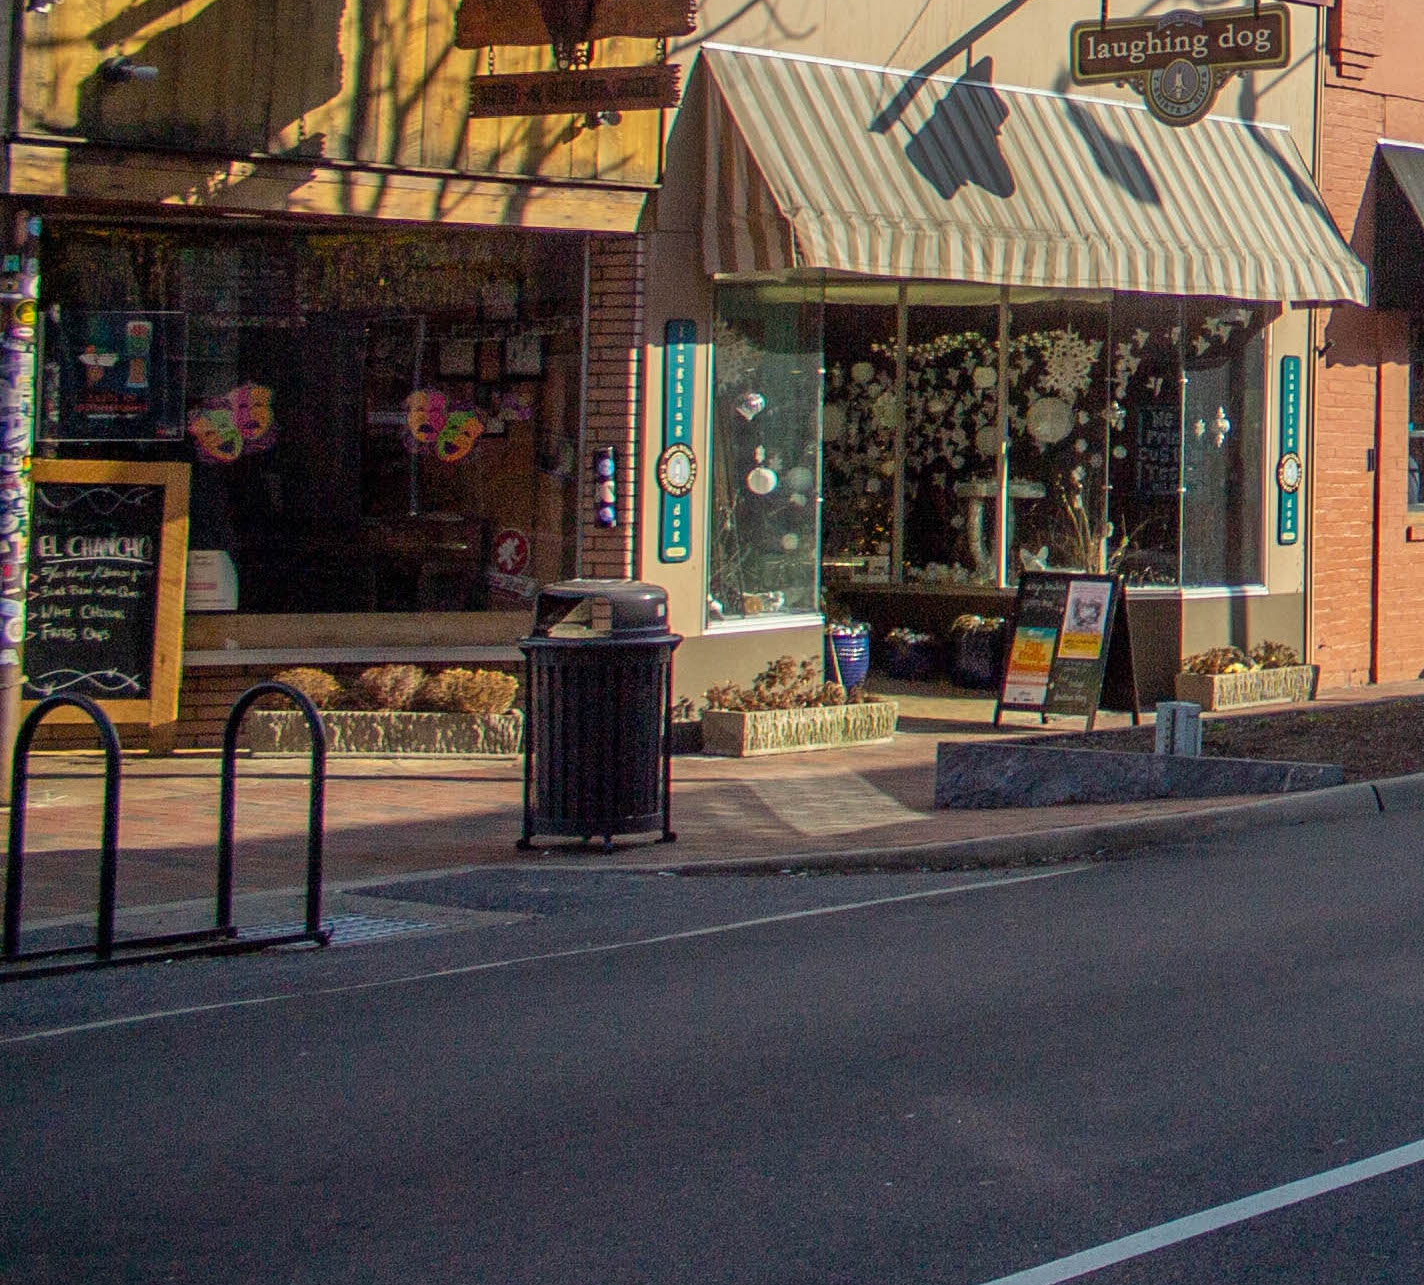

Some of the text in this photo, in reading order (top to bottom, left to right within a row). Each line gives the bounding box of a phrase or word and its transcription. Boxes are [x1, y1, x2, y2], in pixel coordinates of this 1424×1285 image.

[1087, 23, 1272, 64] laughing dog
[39, 534, 64, 558] EL
